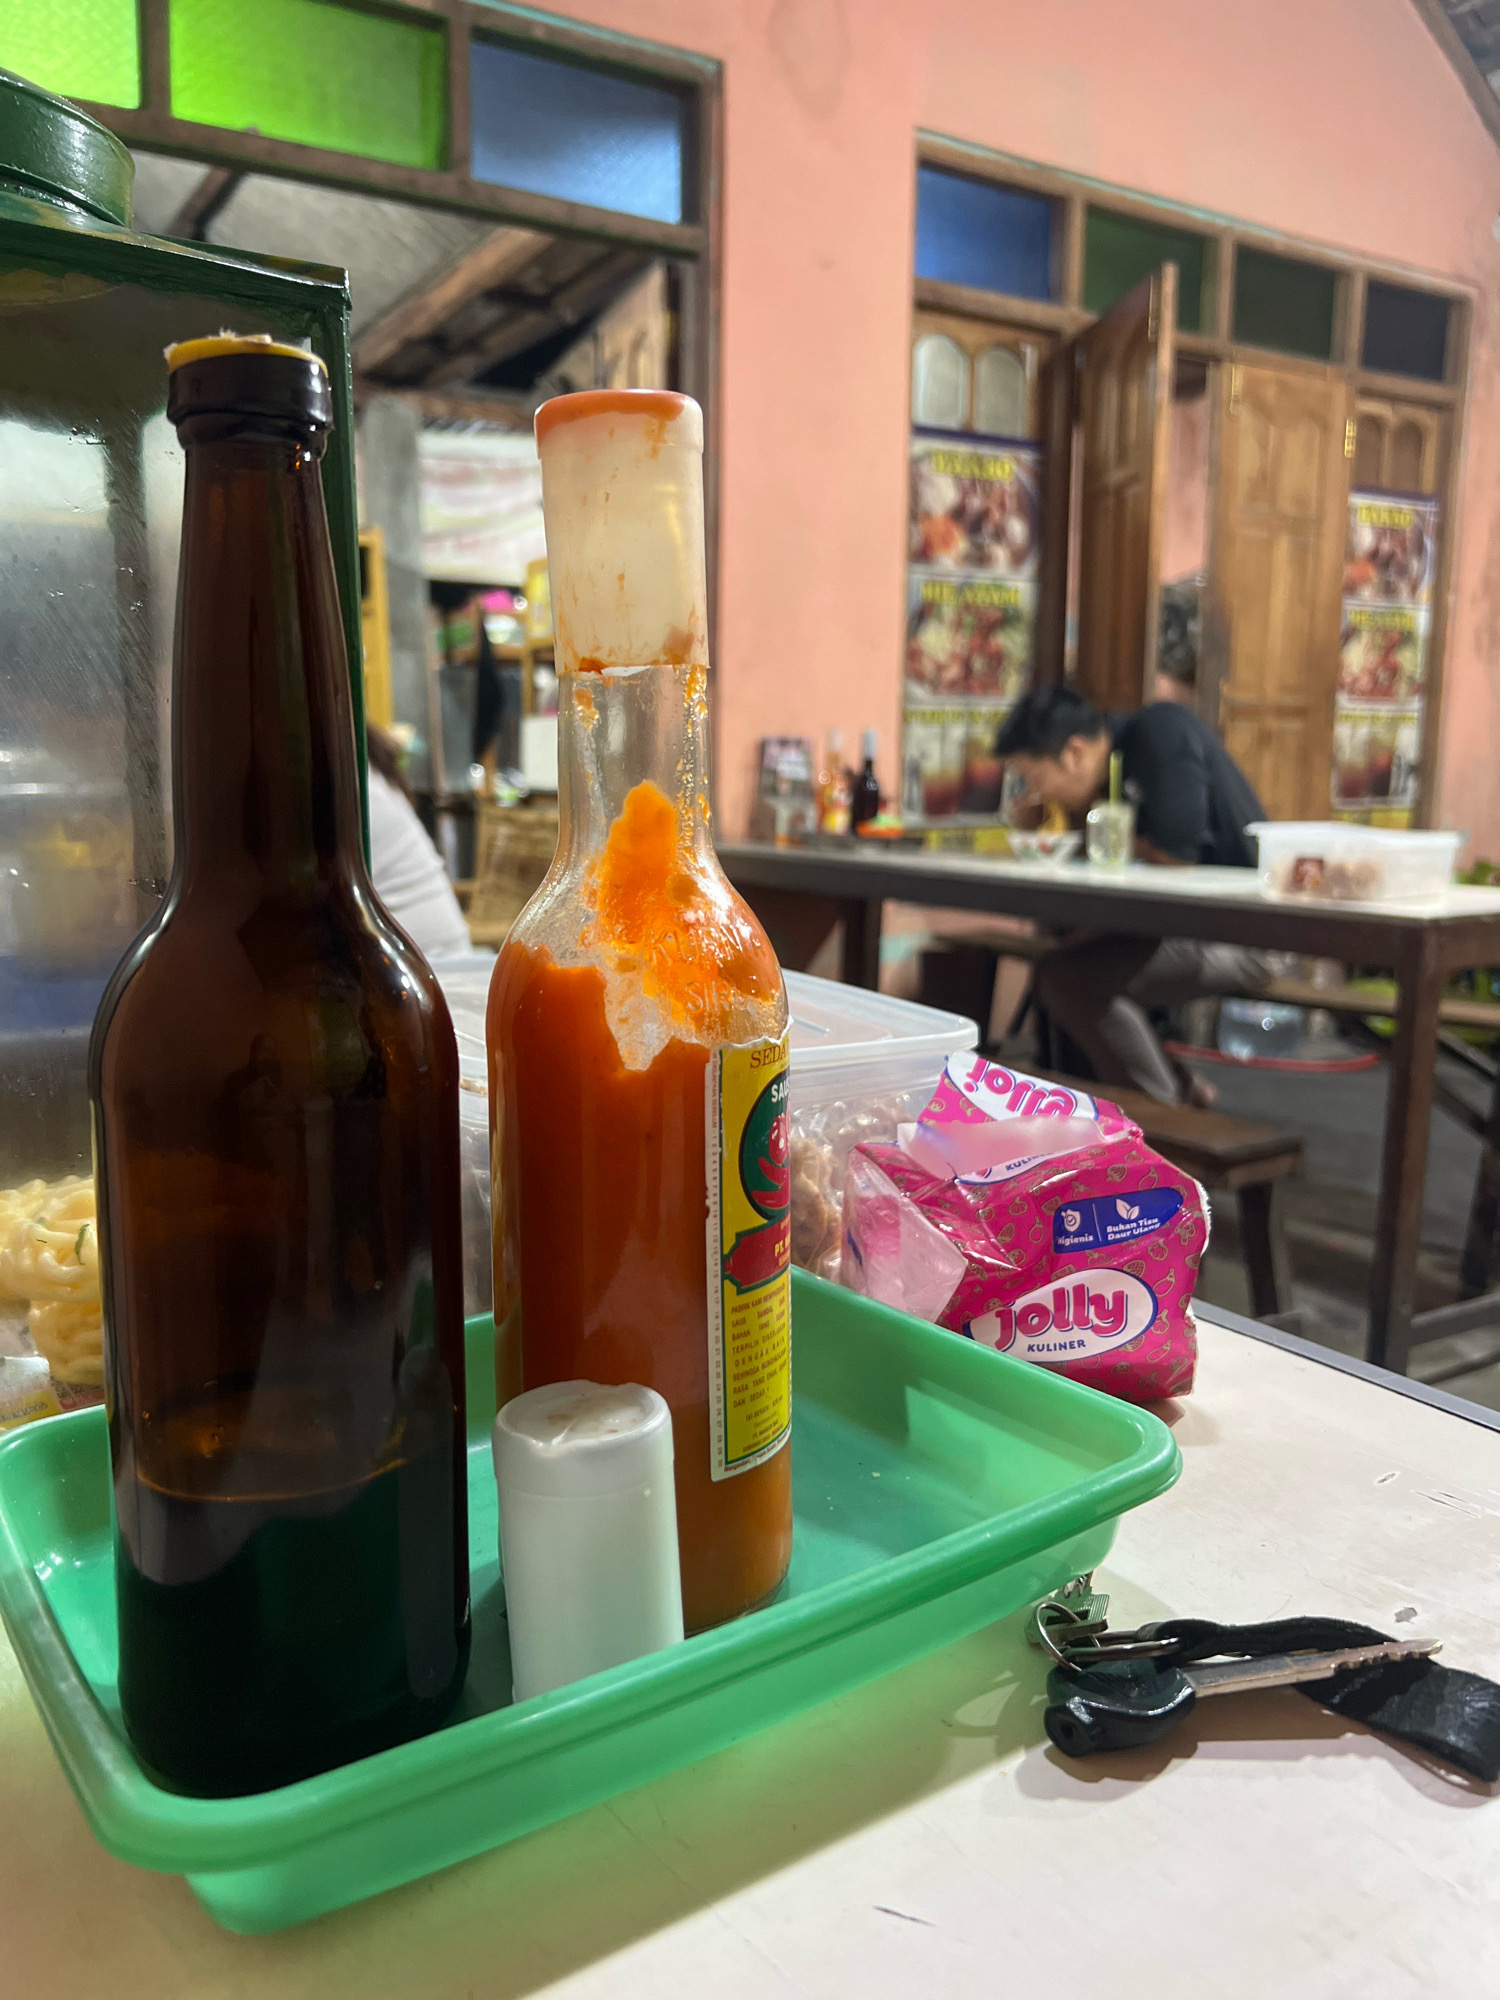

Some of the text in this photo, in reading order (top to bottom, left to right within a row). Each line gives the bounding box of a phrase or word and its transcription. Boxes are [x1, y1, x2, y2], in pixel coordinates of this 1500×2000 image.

[750, 1043, 789, 1069] SEDA
[1106, 1217, 1159, 1233] Bukan Tisu
[1107, 1222, 1160, 1240] Daur Ulang
[994, 1283, 1128, 1352] jolly
[1027, 1339, 1086, 1352] KULINER
[732, 1383, 748, 1395] RASA
[732, 1397, 746, 1408] DAN
